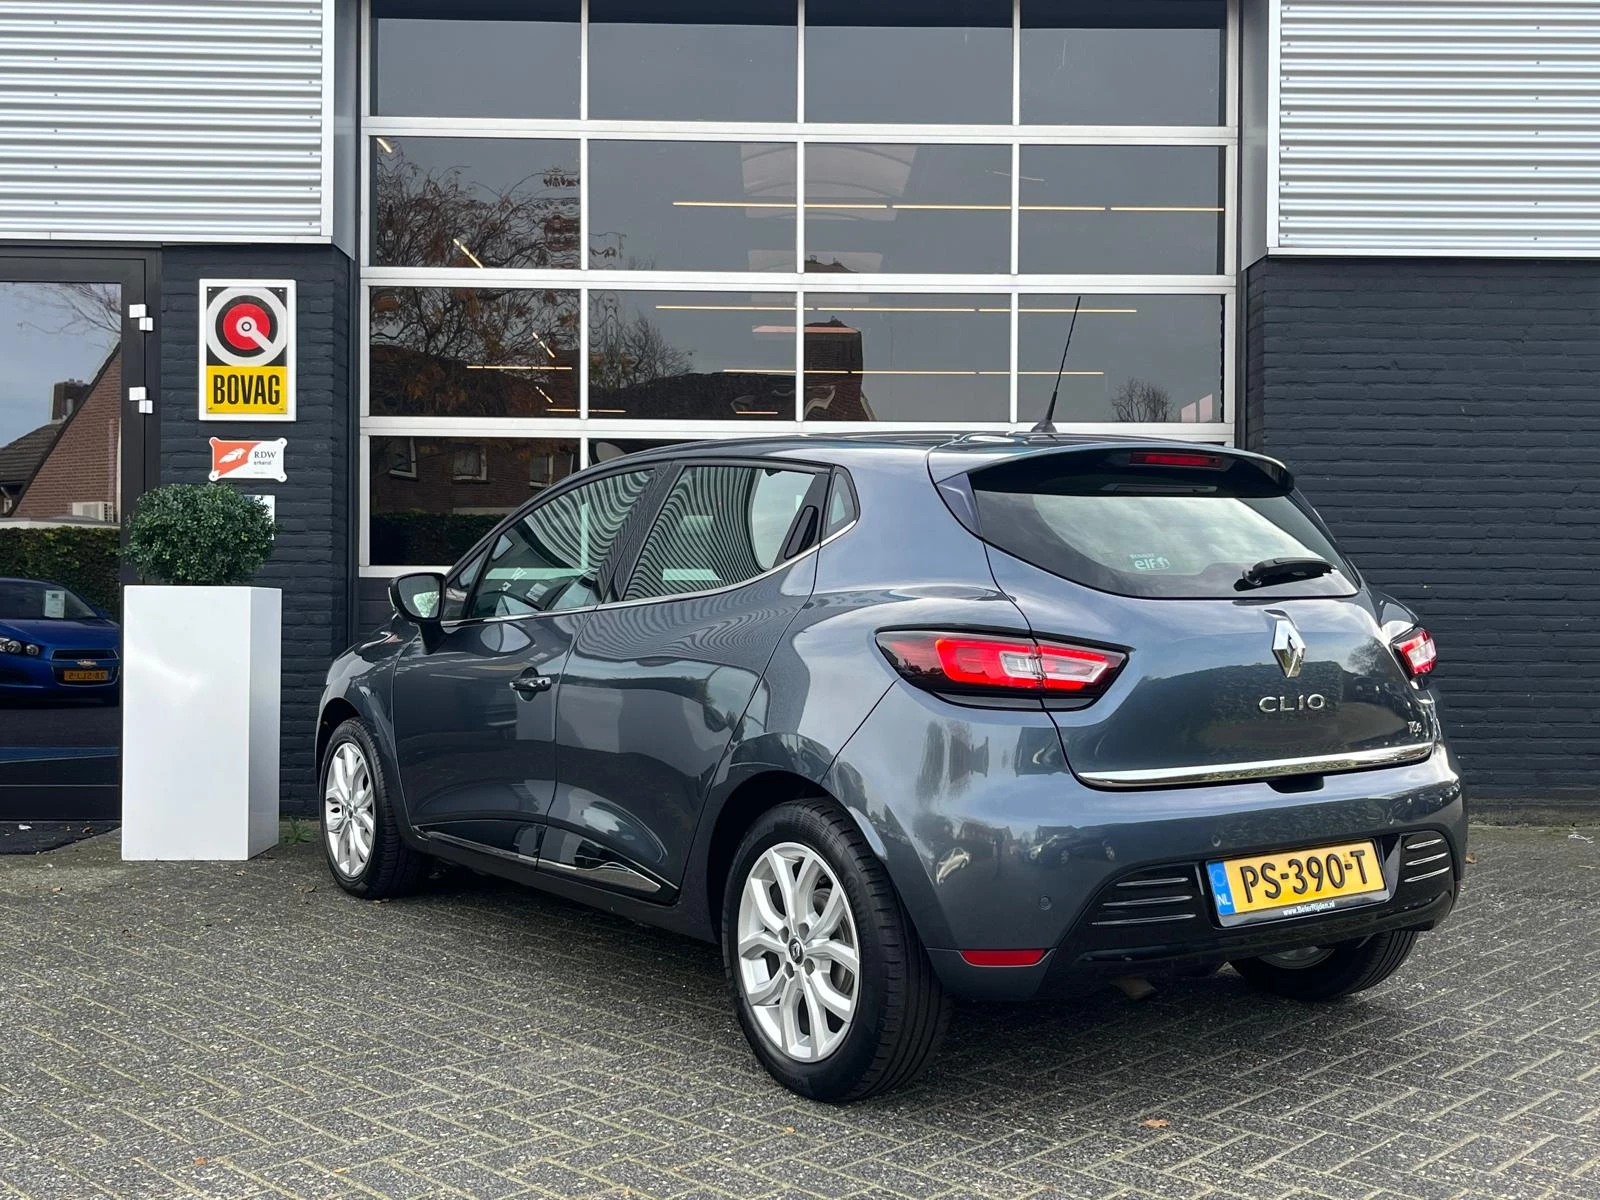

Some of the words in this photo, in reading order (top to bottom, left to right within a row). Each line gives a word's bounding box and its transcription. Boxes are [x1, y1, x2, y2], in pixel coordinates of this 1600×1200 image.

[213, 374, 281, 405] BOVAG
[254, 450, 276, 459] RDW
[1258, 694, 1326, 713] CLIO
[1239, 850, 1368, 904] PS-390-T
[1216, 893, 1232, 906] NL
